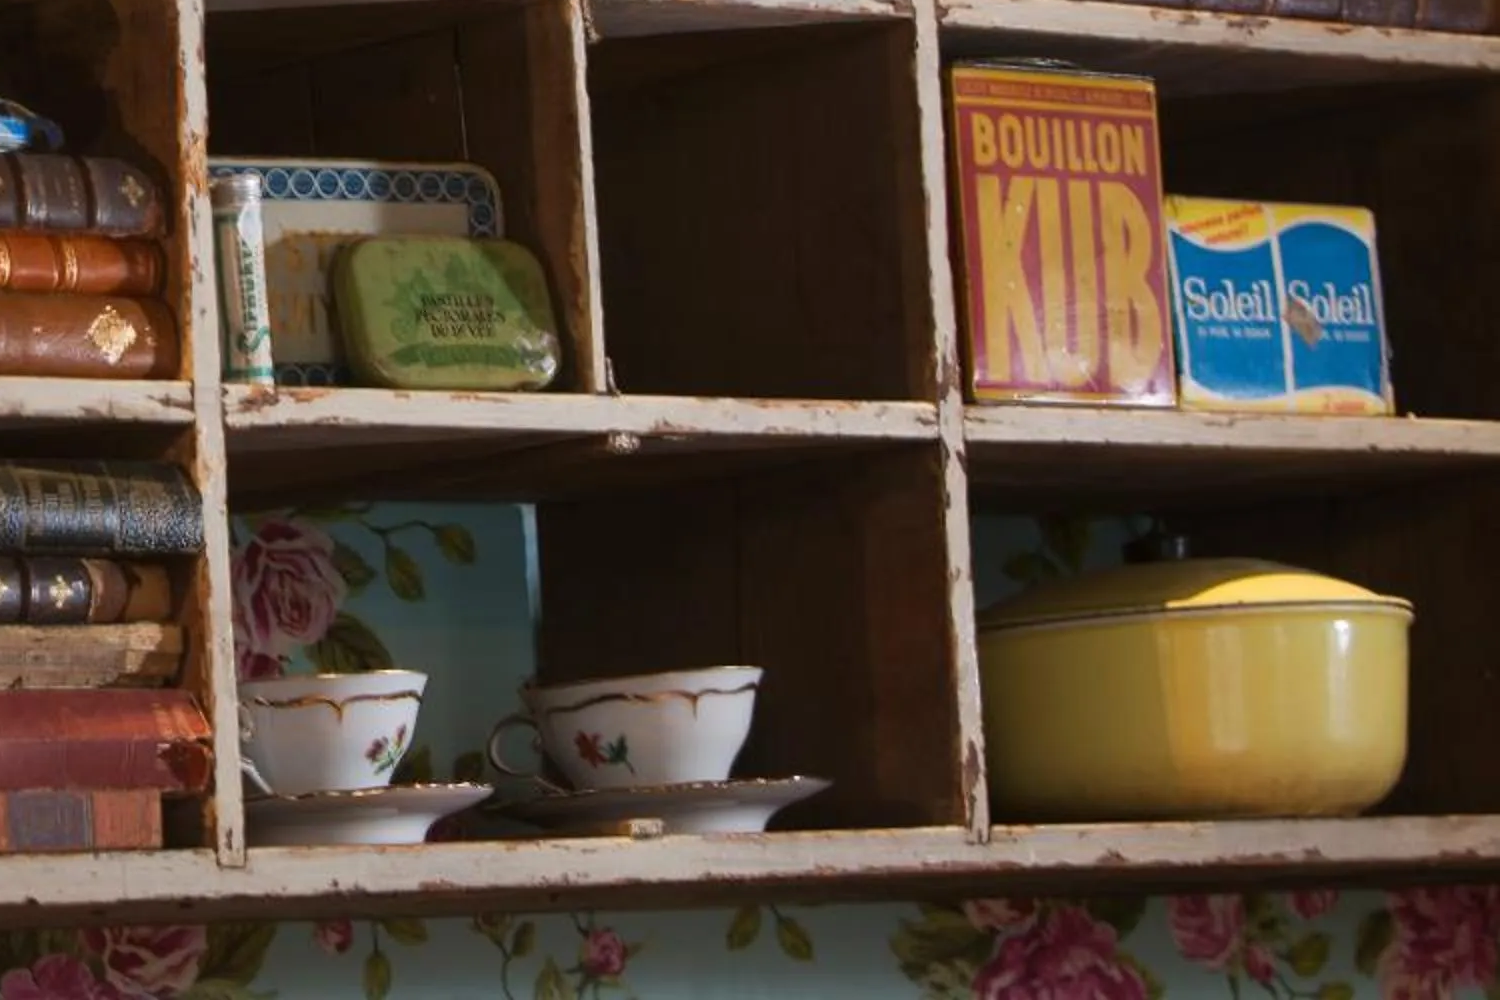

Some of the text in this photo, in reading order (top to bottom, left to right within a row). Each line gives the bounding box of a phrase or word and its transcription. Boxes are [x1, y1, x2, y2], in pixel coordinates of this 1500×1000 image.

[971, 112, 1148, 176] BOUILLON
[976, 173, 1163, 389] KUB
[1183, 274, 1277, 322] Soleil
